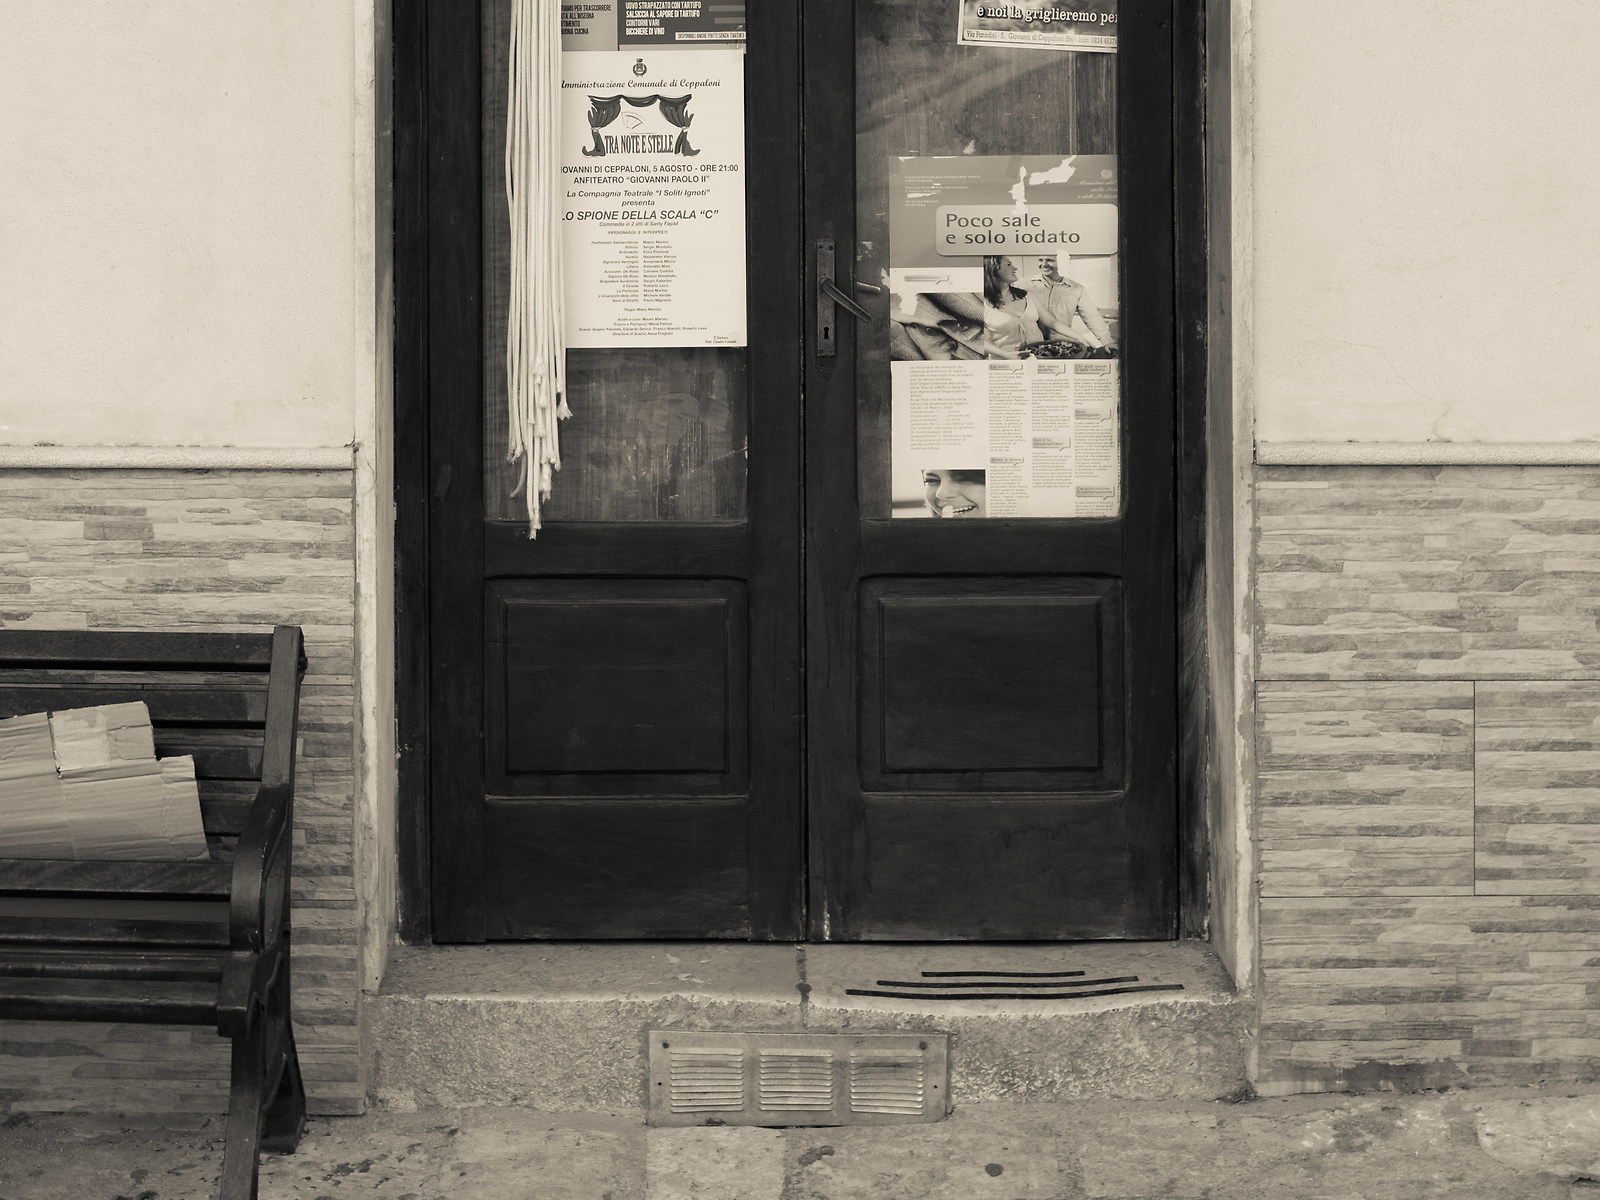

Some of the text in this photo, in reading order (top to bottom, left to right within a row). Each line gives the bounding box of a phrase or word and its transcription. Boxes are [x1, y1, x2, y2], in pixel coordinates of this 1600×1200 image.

[977, 6, 984, 17] e
[987, 6, 1006, 18] noi
[1010, 6, 1023, 18] la
[1025, 7, 1097, 23] griglieremo
[628, 80, 668, 88] Comunale
[680, 79, 721, 89] Ceppaloni
[604, 134, 674, 154] TRA NOTE E STELLE
[578, 190, 621, 198] Compagnia
[577, 211, 619, 220] SPIONE
[621, 210, 657, 220] DELLA
[660, 210, 696, 220] SCALA
[700, 210, 719, 219] "C"
[946, 213, 1040, 228] Poco sale
[945, 230, 1080, 244] e solo iodato
